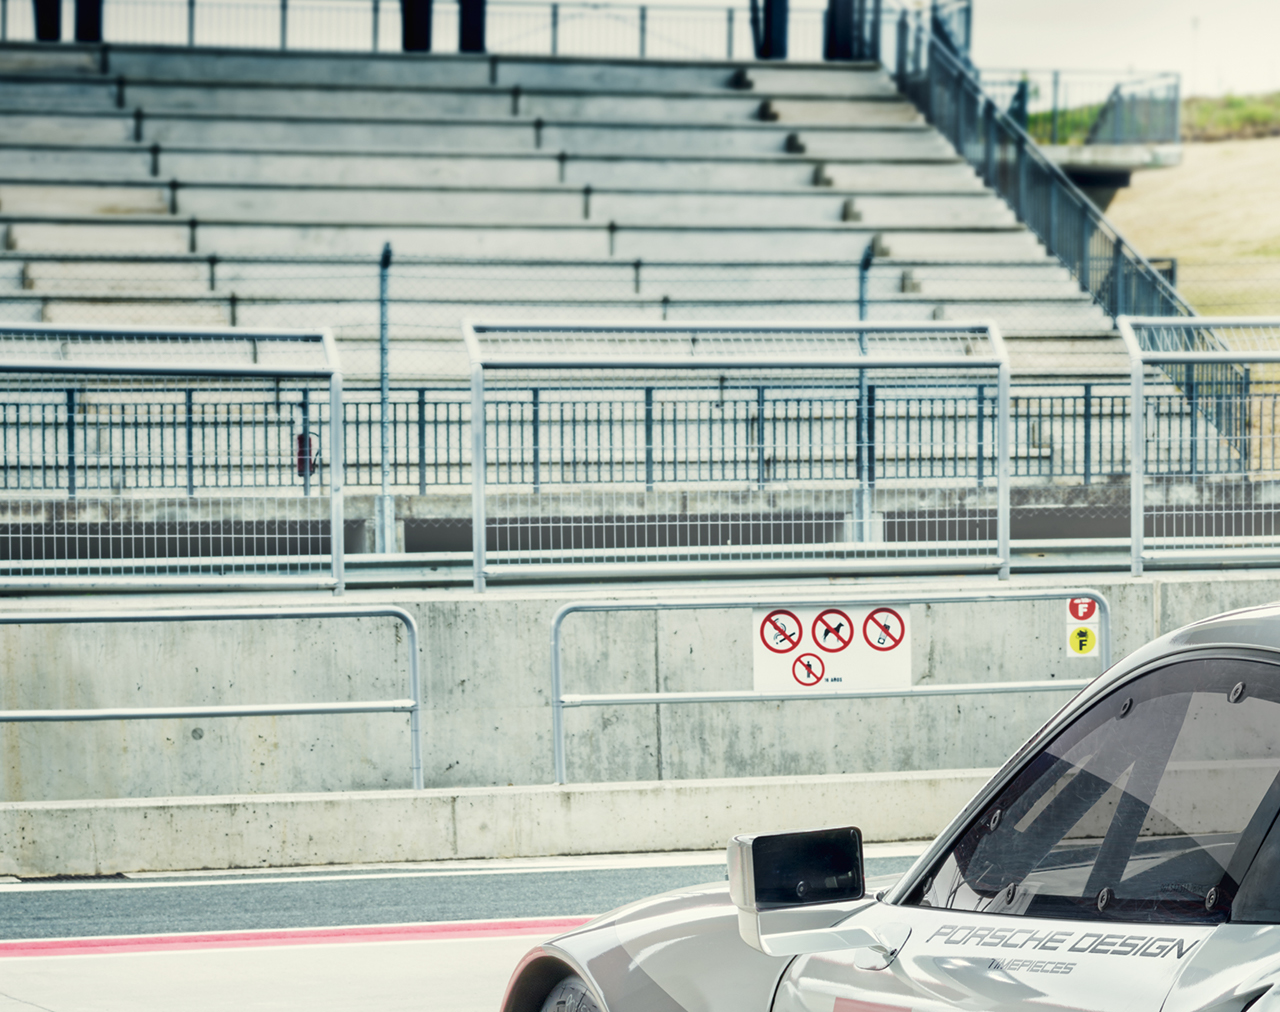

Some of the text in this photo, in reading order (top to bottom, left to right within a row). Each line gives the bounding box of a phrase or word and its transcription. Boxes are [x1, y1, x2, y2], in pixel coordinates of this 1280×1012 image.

[1078, 603, 1089, 617] F
[1079, 639, 1088, 651] F
[925, 924, 1200, 960] PORSCHE DESIGN
[987, 958, 1077, 975] TIMEPIECES
